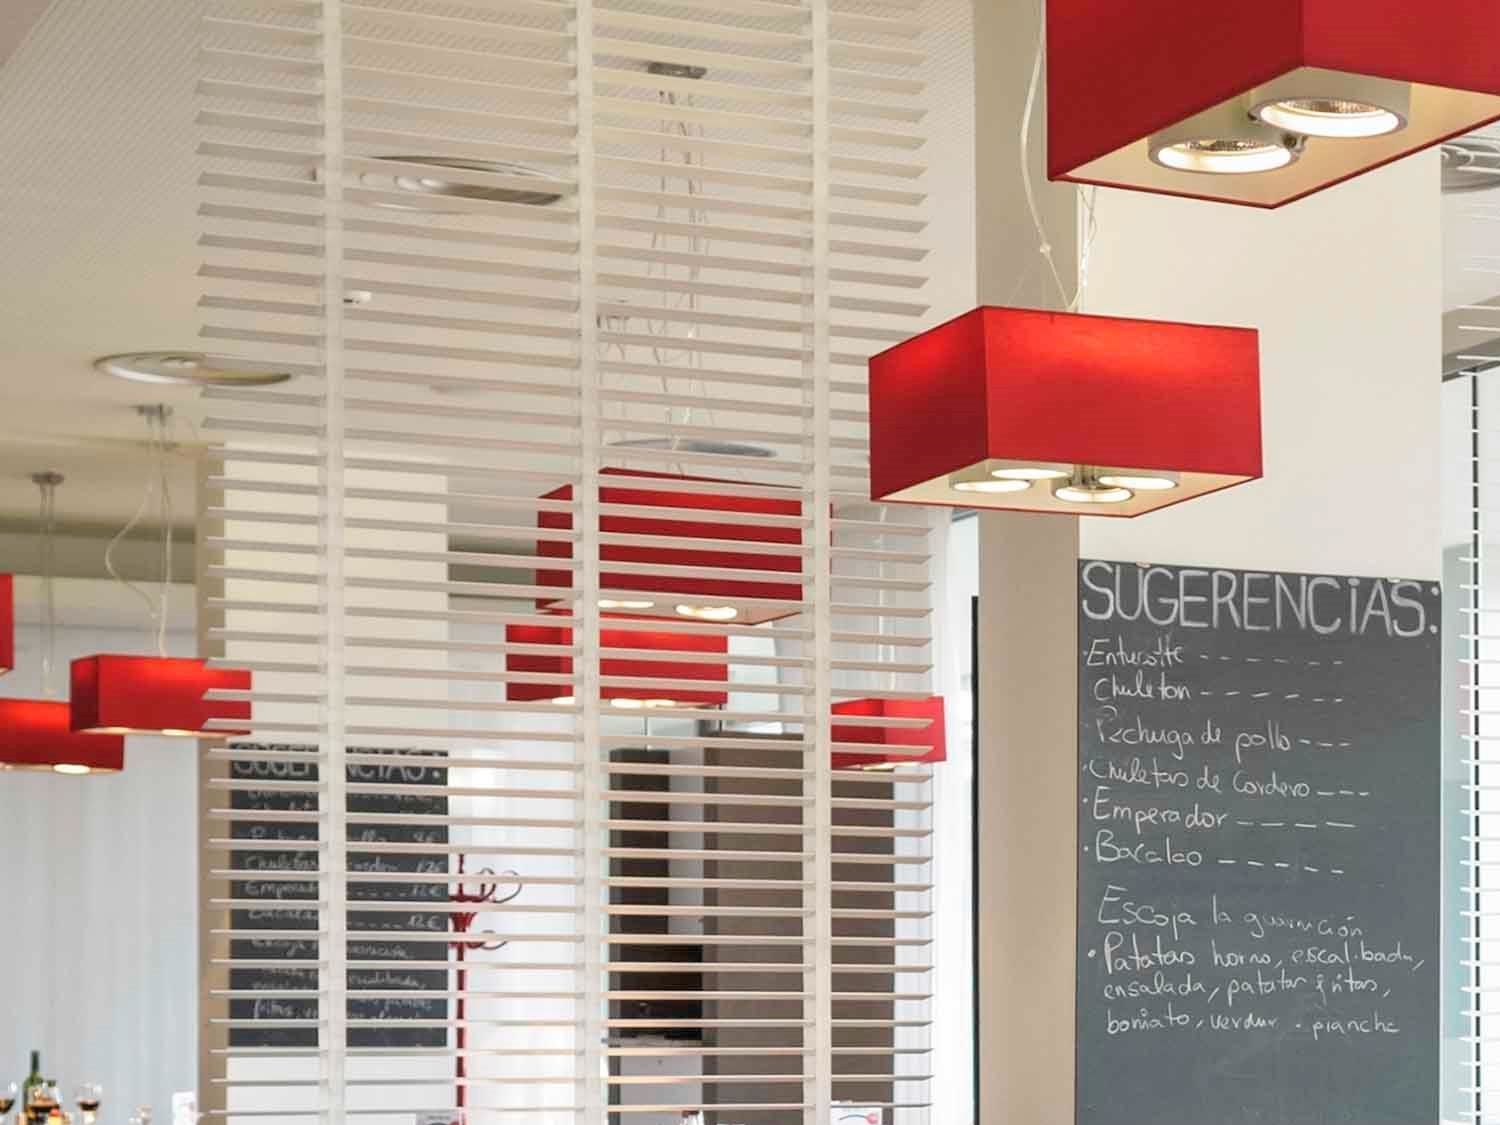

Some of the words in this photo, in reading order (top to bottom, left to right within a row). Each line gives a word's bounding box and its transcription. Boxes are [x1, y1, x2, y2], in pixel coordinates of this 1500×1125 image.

[1201, 719, 1222, 744] de
[1234, 720, 1291, 763] pollo
[1196, 765, 1223, 793] de
[1232, 769, 1310, 799] Cordero
[1093, 786, 1229, 836] Emperador
[1212, 893, 1233, 926] la
[1103, 930, 1197, 975] Patatas
[1103, 970, 1220, 1003] ensalada,
[1106, 1001, 1204, 1035] boniato,
